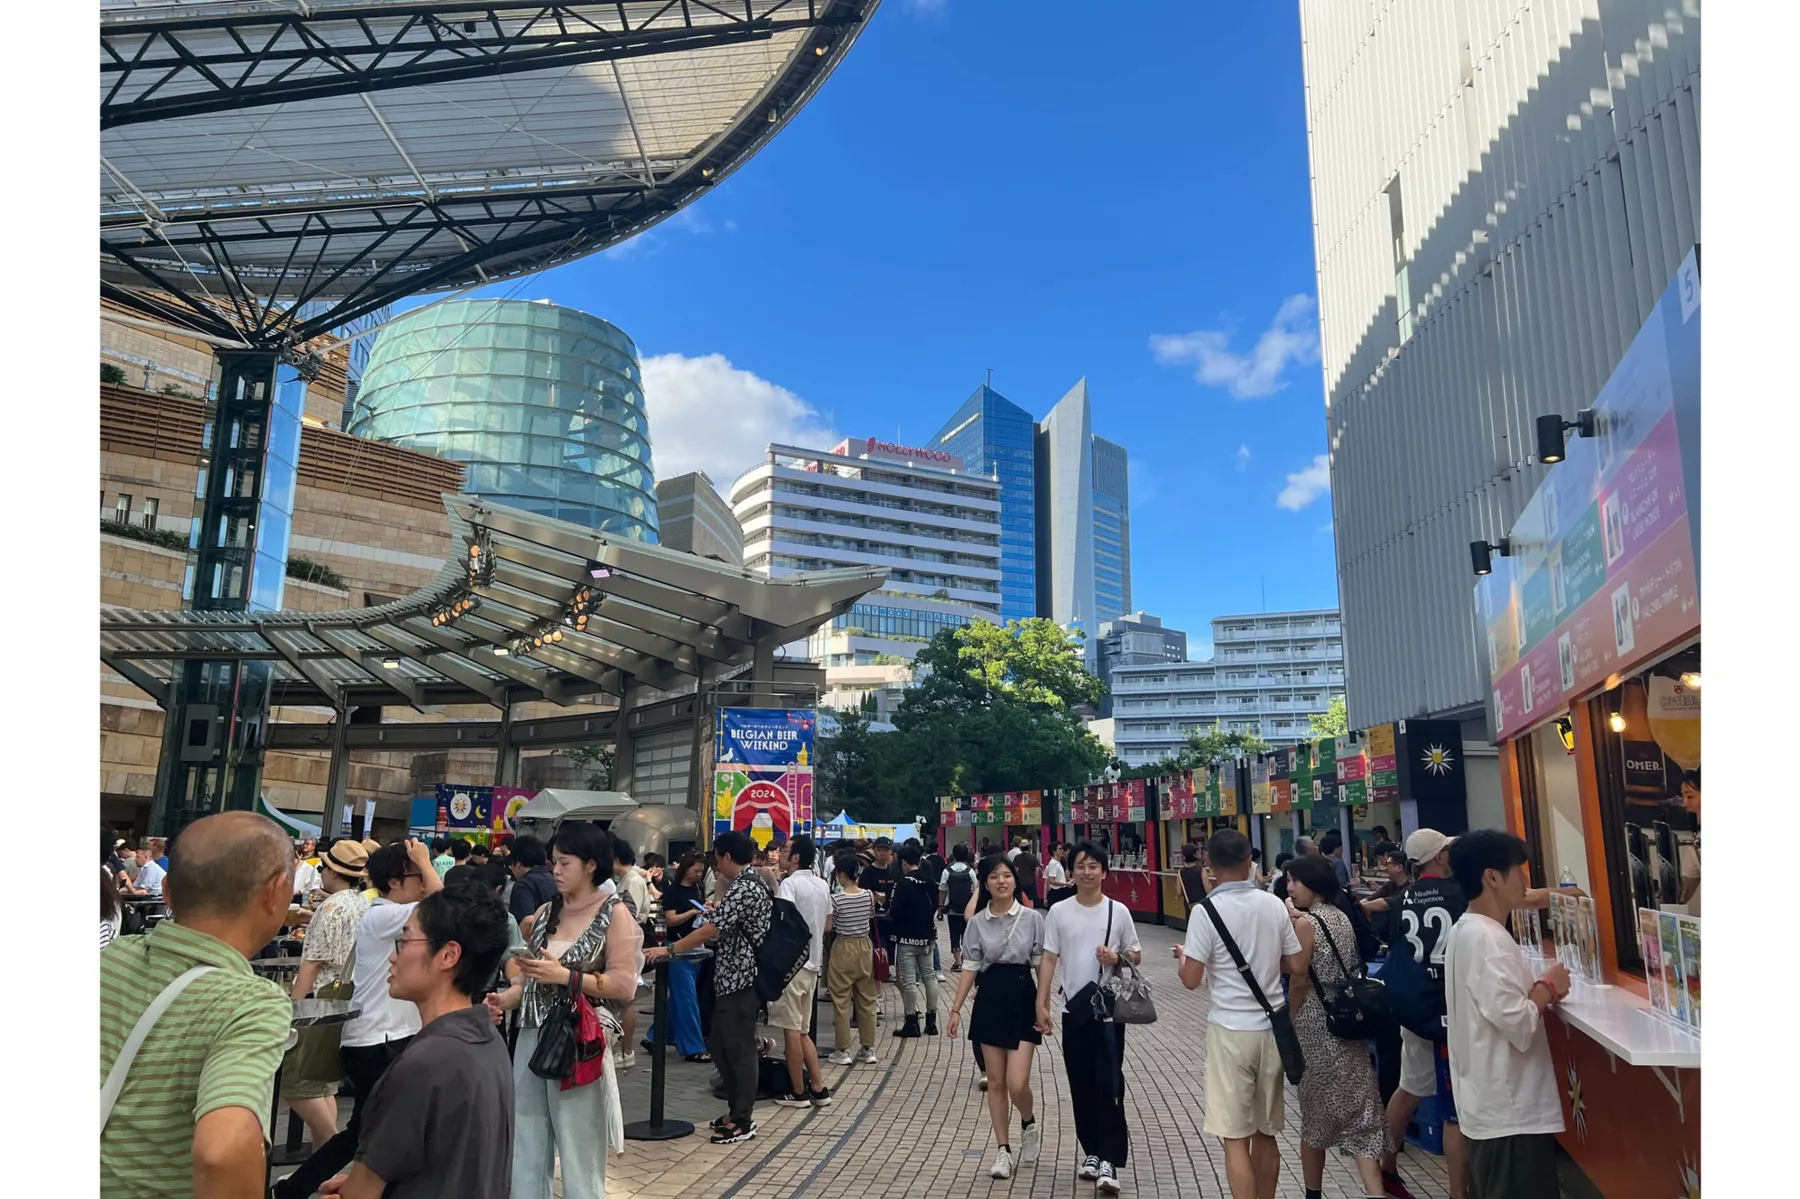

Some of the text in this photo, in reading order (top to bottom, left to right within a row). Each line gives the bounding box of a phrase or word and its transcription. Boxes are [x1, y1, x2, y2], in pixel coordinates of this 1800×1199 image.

[1684, 268, 1694, 303] 5
[877, 442, 951, 463] HOLLYWOOD
[730, 729, 798, 740] BELGIAN BEER
[740, 740, 788, 750] WEEKEND
[750, 790, 775, 798] 2024
[1413, 896, 1444, 904] Corporation
[1402, 906, 1453, 964] 32
[899, 937, 929, 946] ALMOST
